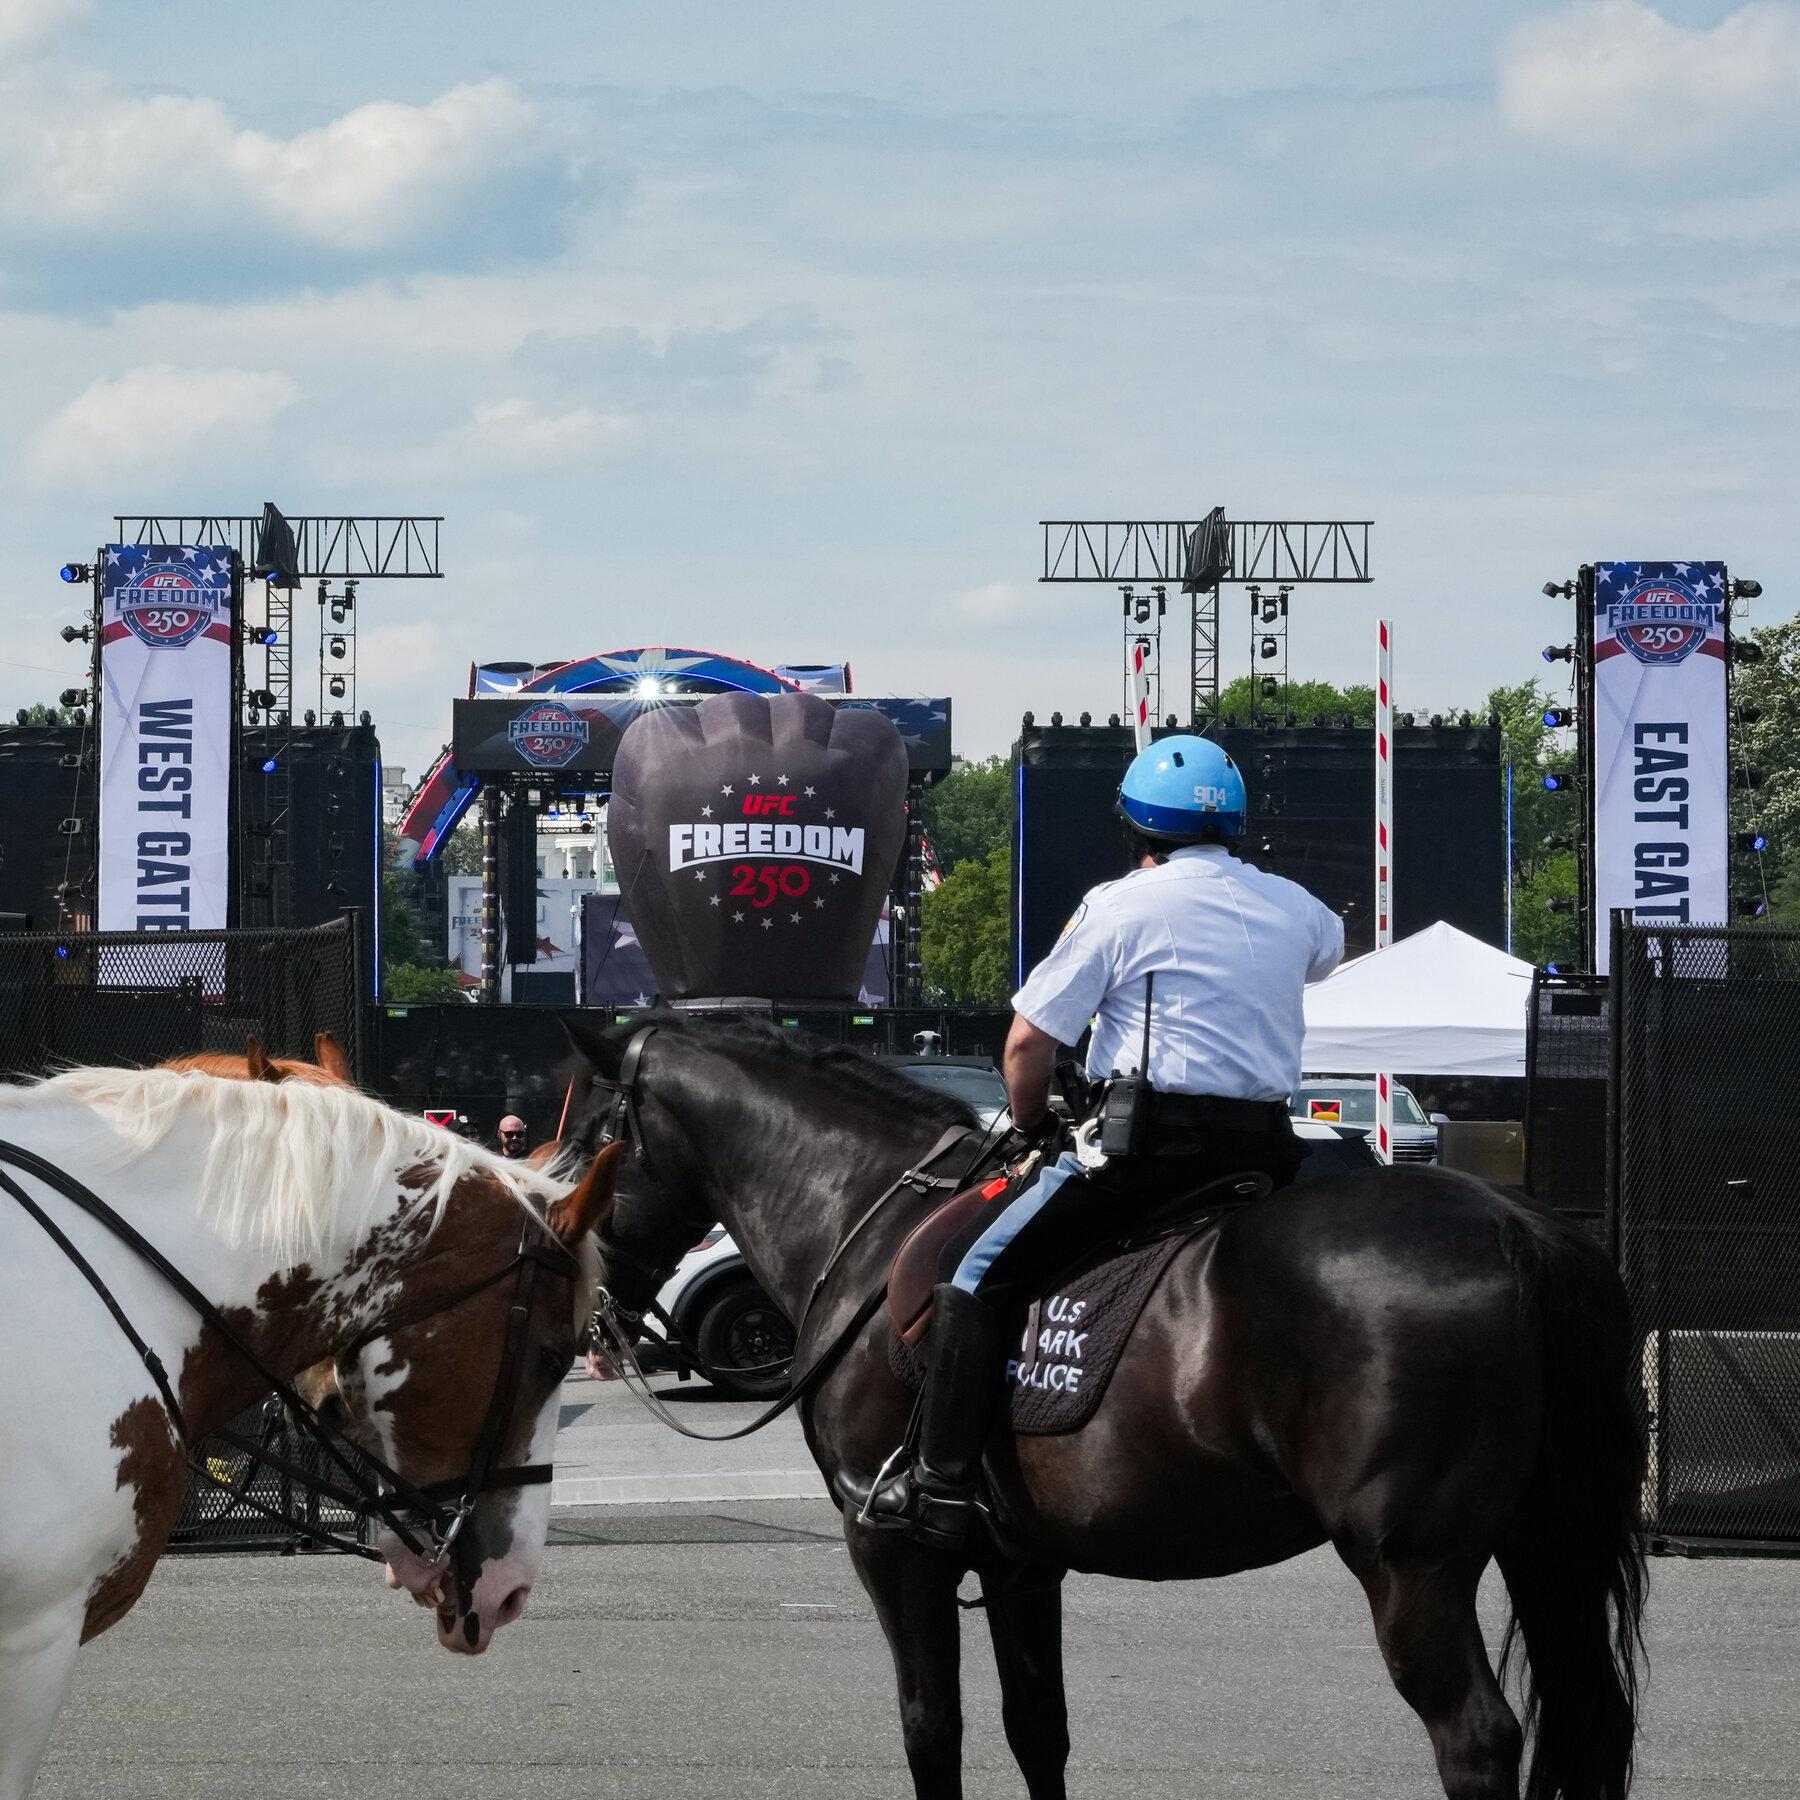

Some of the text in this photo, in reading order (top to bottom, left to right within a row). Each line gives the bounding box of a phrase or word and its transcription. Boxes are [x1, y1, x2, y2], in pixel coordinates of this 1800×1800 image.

[153, 577, 182, 587] UFC
[115, 588, 219, 612] FREEDOM
[1646, 593, 1675, 603] UFC
[146, 611, 189, 633] 250
[1608, 605, 1714, 628] FREEDOM
[1641, 627, 1684, 650] 250
[509, 721, 588, 739] FREEDOM
[534, 738, 565, 754] 250
[1634, 723, 1689, 829] EAST
[742, 795, 797, 816] UFC
[1194, 785, 1226, 805] 904
[137, 699, 193, 931] WEST GATE
[669, 823, 865, 876] FREEDOM
[729, 865, 810, 908] 250
[453, 917, 482, 930] FREE
[470, 928, 482, 940] 25
[1007, 1359, 1083, 1393] POLICE
